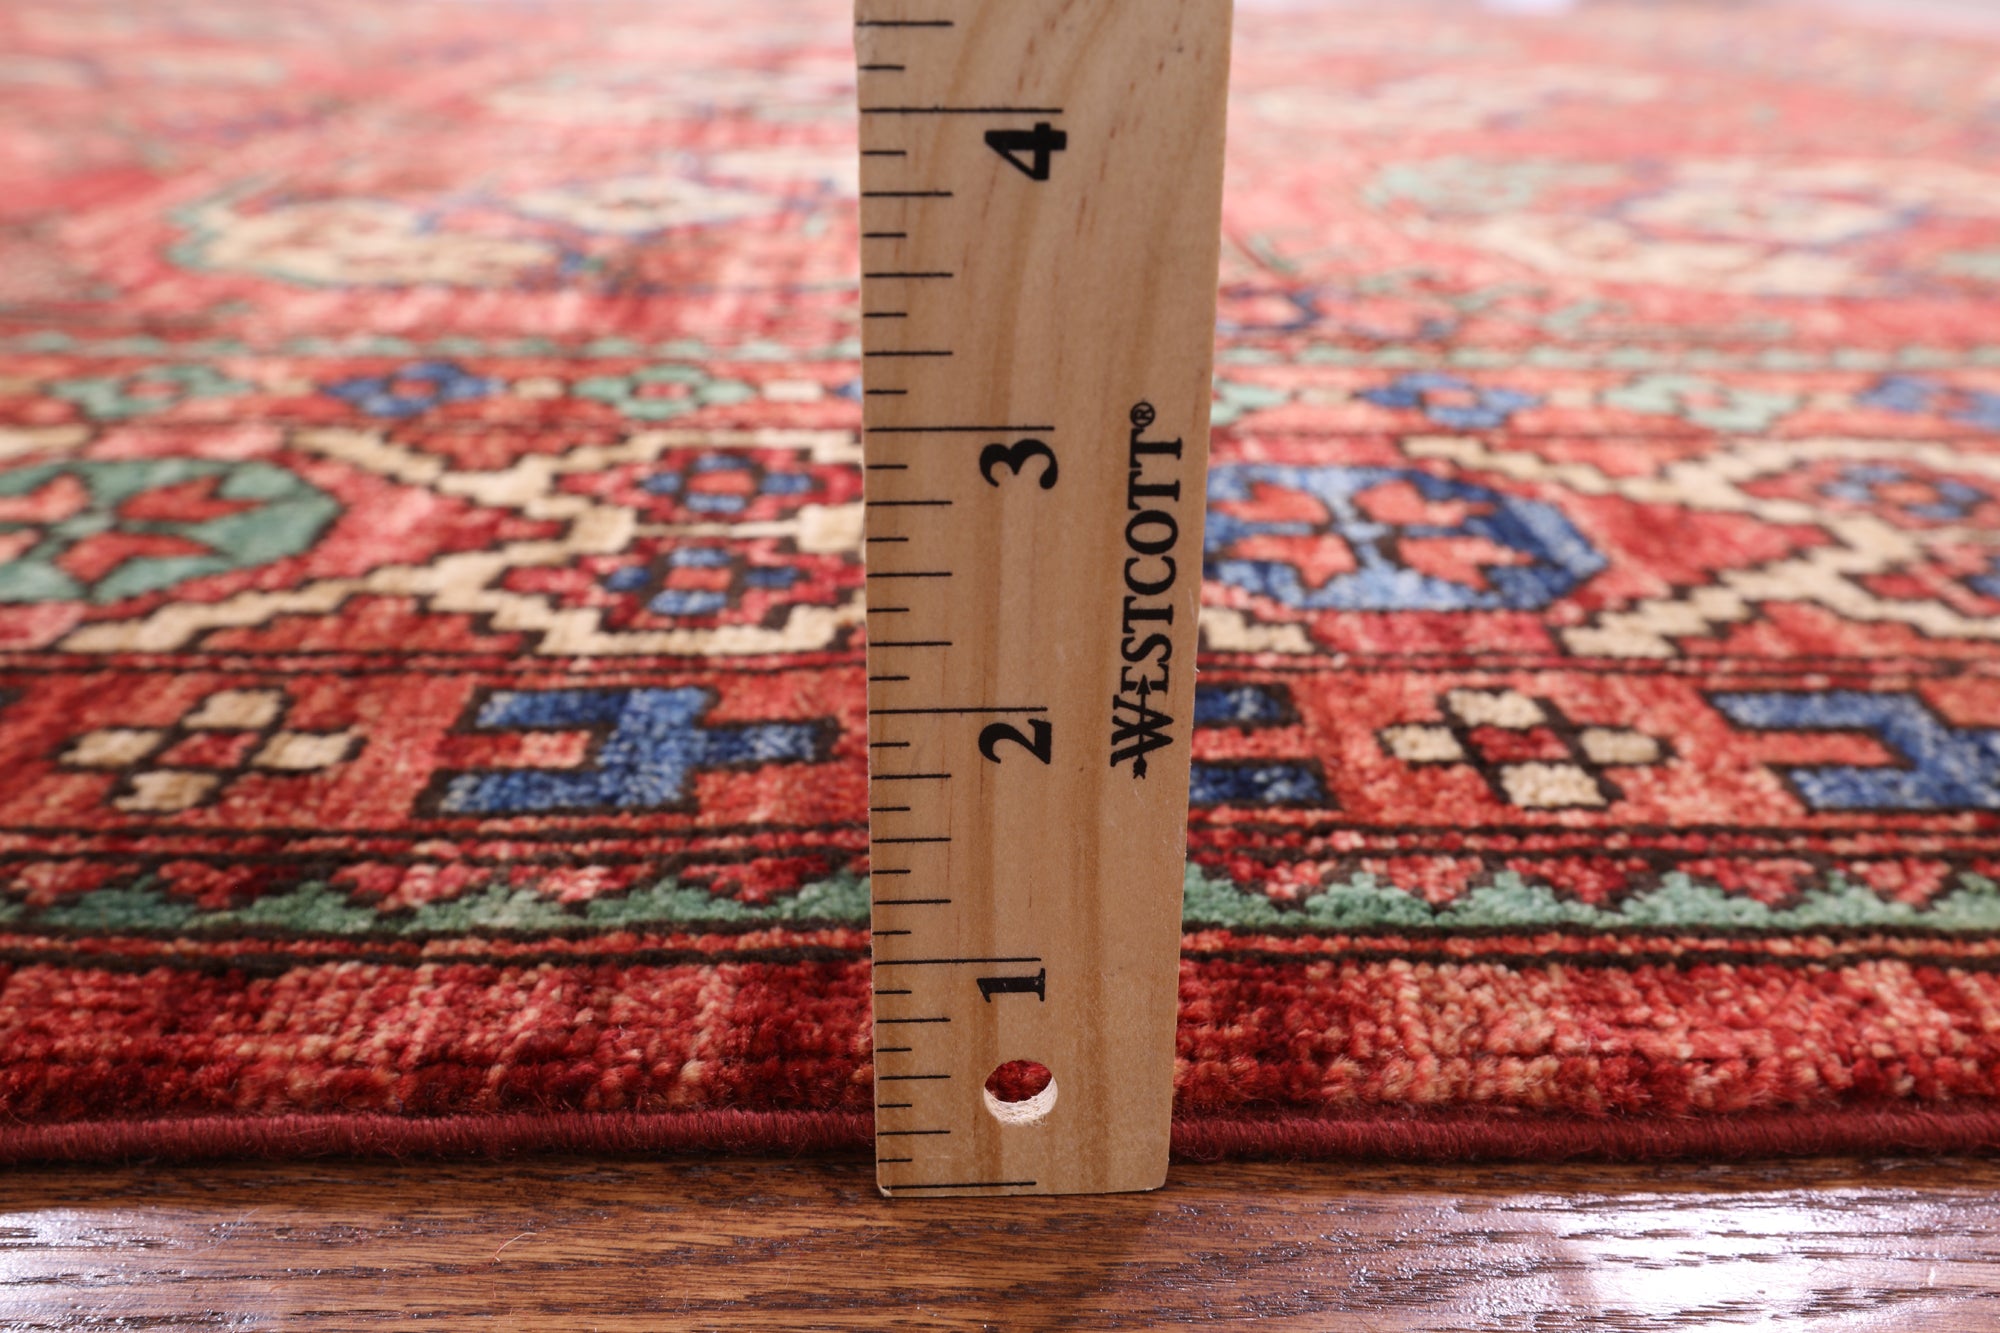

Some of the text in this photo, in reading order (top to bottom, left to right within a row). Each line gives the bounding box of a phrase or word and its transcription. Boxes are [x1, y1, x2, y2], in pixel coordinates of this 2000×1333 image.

[984, 122, 1067, 181] 4
[978, 438, 1059, 490] 3
[978, 718, 1052, 765] 2
[976, 967, 1046, 1003] 1
